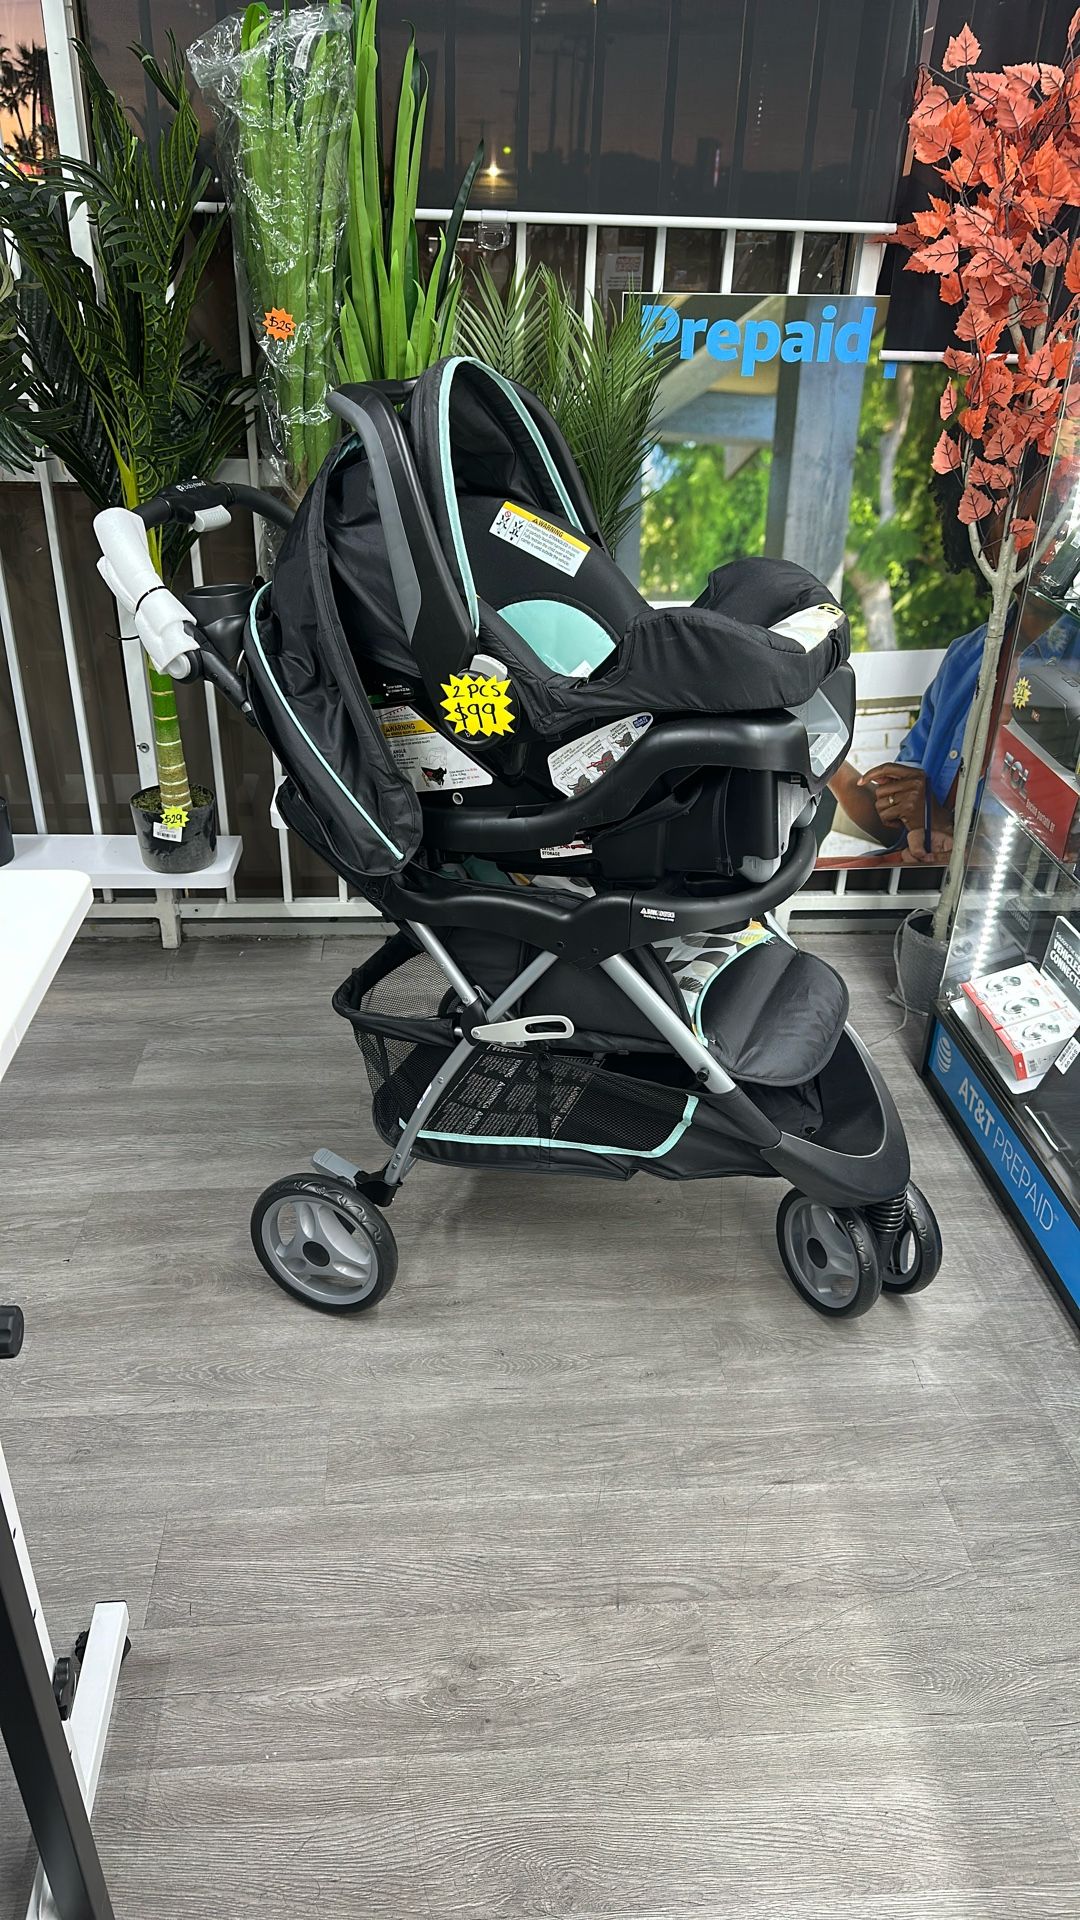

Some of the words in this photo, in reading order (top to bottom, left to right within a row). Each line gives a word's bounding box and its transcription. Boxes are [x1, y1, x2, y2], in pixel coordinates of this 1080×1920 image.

[268, 316, 291, 332] $25
[641, 304, 877, 376] Prepaid
[537, 520, 563, 537] WARNING
[453, 685, 465, 698] 2
[467, 684, 501, 698] PCS
[454, 702, 497, 729] $99
[1050, 949, 1080, 992] CONNECTE
[958, 1077, 995, 1137] AT&T
[993, 1126, 1054, 1231] PREPAID
